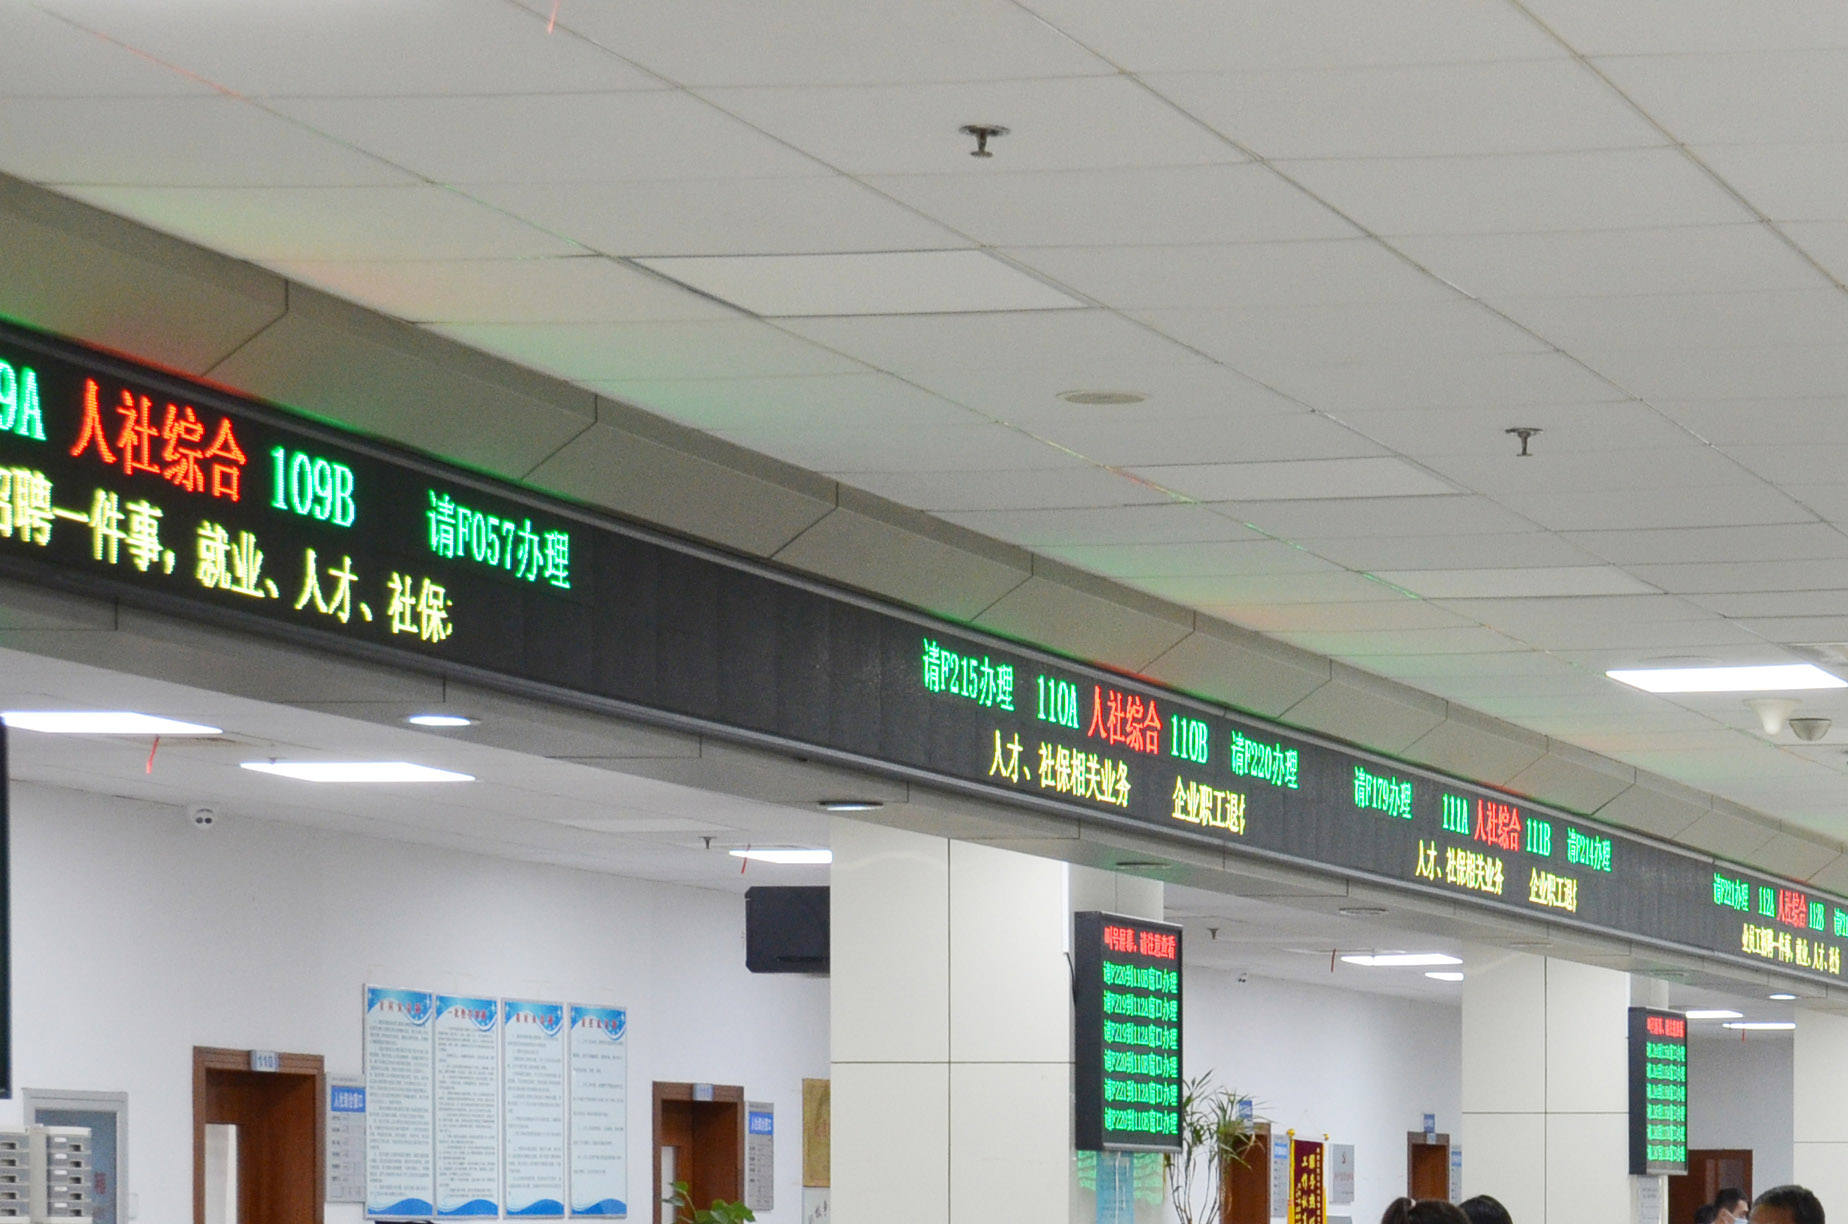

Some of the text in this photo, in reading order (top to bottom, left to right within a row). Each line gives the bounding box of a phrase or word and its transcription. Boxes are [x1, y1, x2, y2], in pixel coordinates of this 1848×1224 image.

[70, 377, 245, 502] 人社综合
[270, 446, 355, 527] 109B
[427, 489, 570, 588] 请F057办理
[922, 638, 1299, 788] 请F215办理 110A 人社综合 110B 请F220办理
[989, 729, 1131, 807] 人才、社保相关业务
[1354, 766, 1412, 819] 请F179办理
[1442, 794, 1469, 834] 111A
[1474, 799, 1521, 851] 人社综合
[1526, 817, 1551, 856] 111B
[1415, 839, 1504, 895] 人才、社保相关业务
